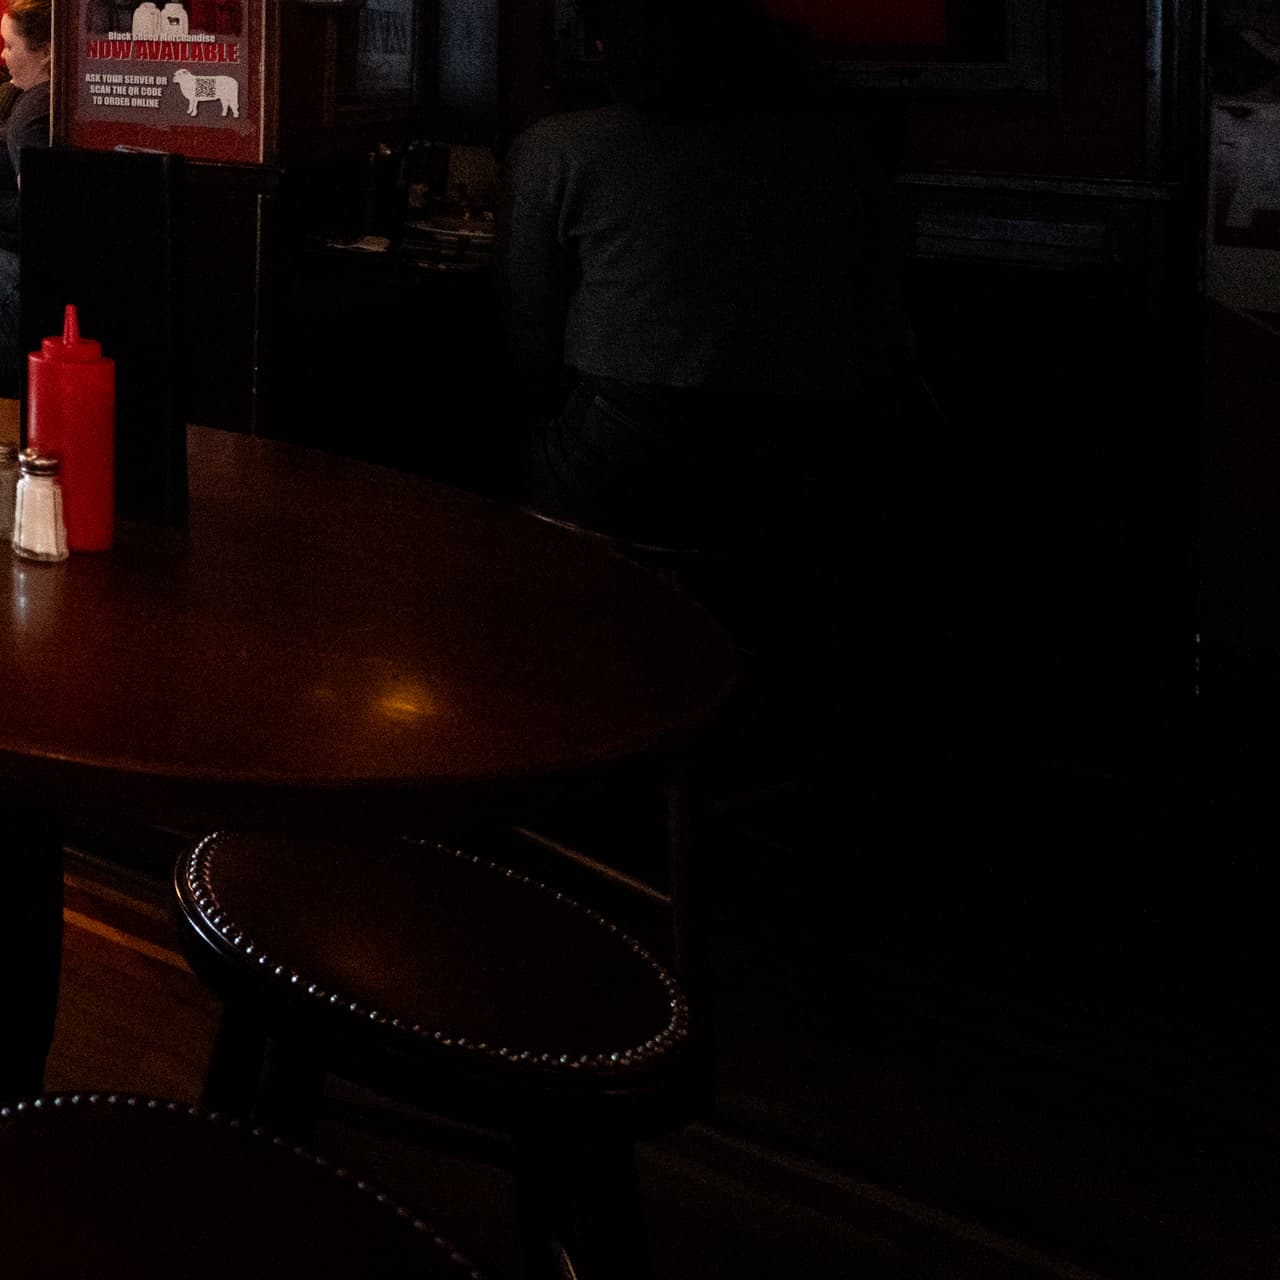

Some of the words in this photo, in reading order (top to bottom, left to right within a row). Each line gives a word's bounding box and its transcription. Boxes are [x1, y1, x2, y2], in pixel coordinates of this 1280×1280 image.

[108, 31, 131, 41] Black
[133, 32, 159, 42] Sheep
[160, 32, 215, 42] Merchandise
[86, 40, 133, 60] NOW
[136, 40, 240, 64] AVAILABLE
[85, 73, 101, 82] ASK
[102, 74, 123, 83] YOUR
[124, 75, 154, 85] SERVER
[156, 76, 167, 85] OR
[90, 85, 111, 94] SCAN
[112, 86, 127, 95] THE
[128, 86, 139, 96] QR
[140, 87, 162, 96] CODE
[93, 96, 102, 105] TO
[104, 96, 130, 106] ORDER
[131, 97, 159, 108] ONLINE
